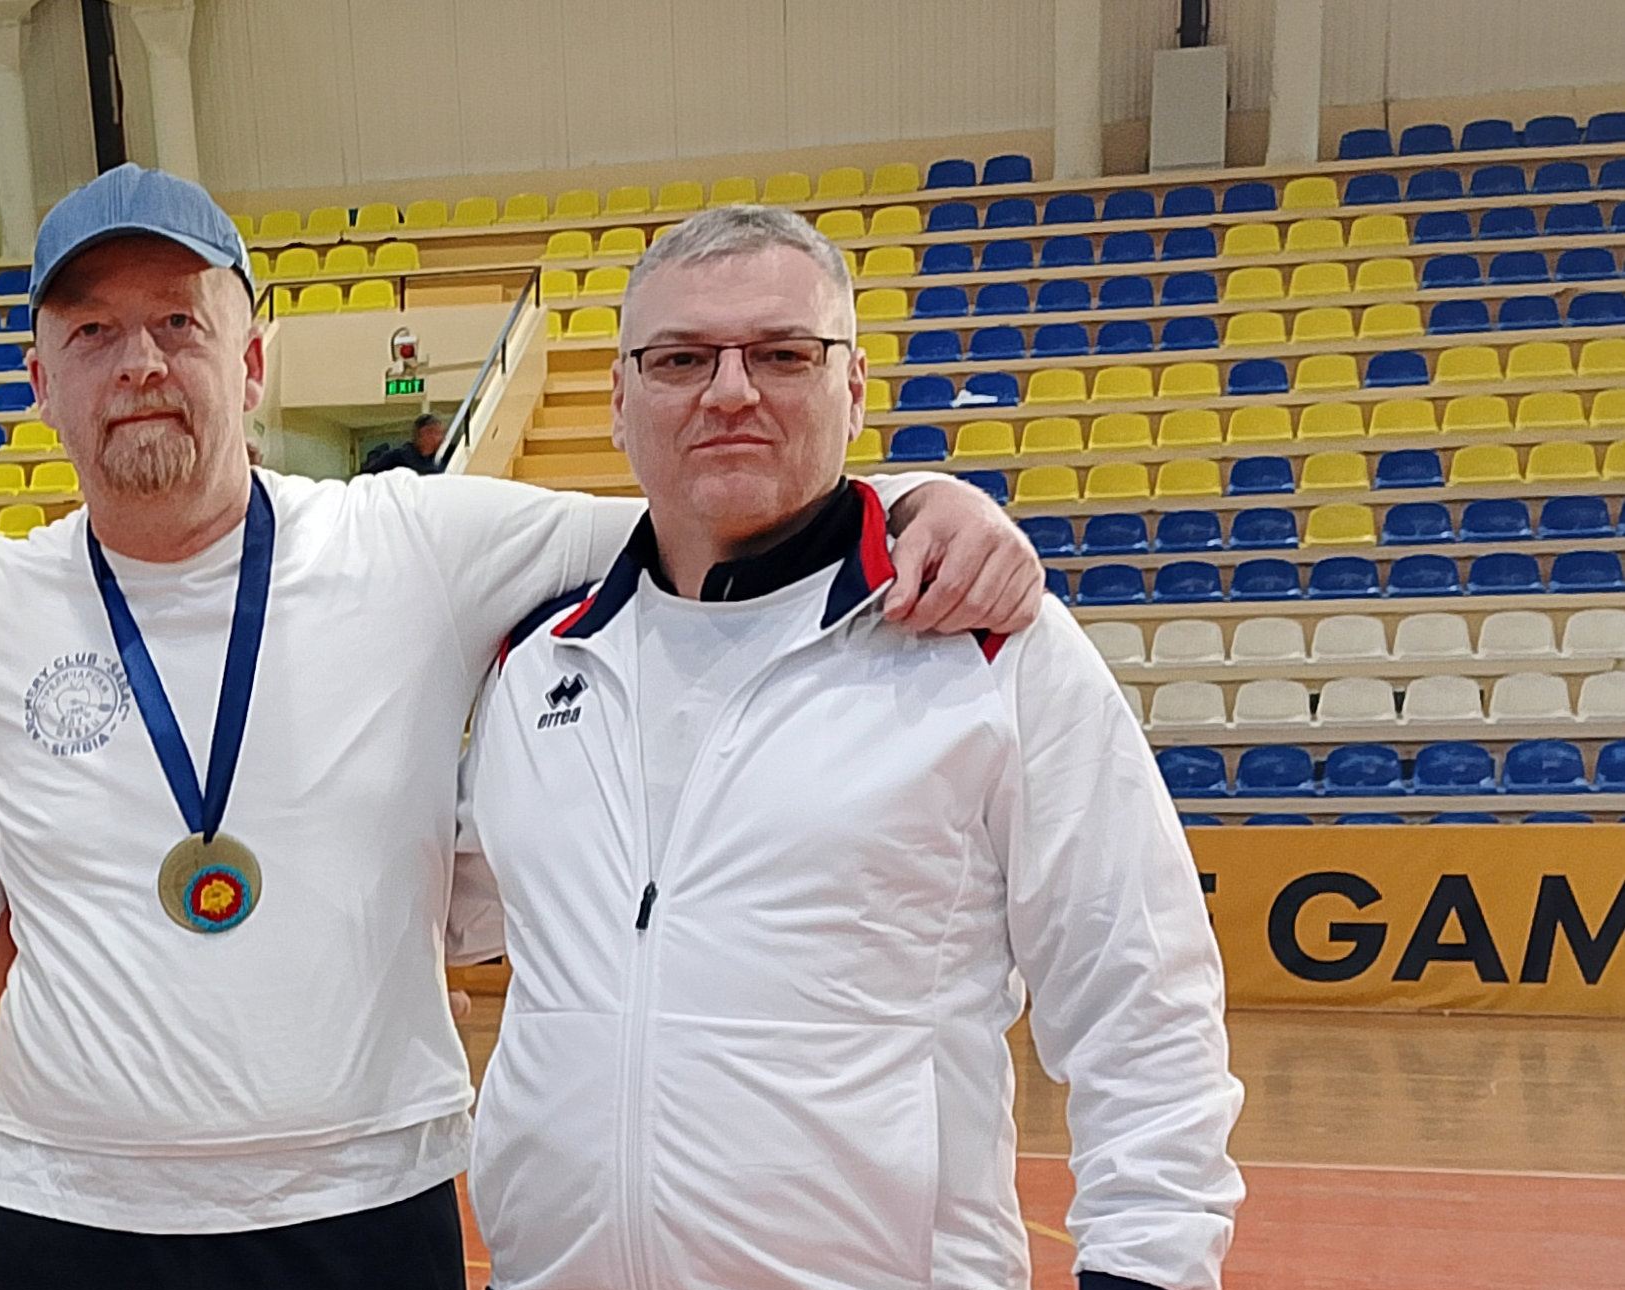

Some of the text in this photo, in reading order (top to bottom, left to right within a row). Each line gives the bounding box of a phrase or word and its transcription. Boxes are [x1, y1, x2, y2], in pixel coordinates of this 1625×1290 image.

[388, 380, 421, 394] EXIT
[53, 651, 98, 669] CLUB
[1267, 870, 1625, 986] GAM
